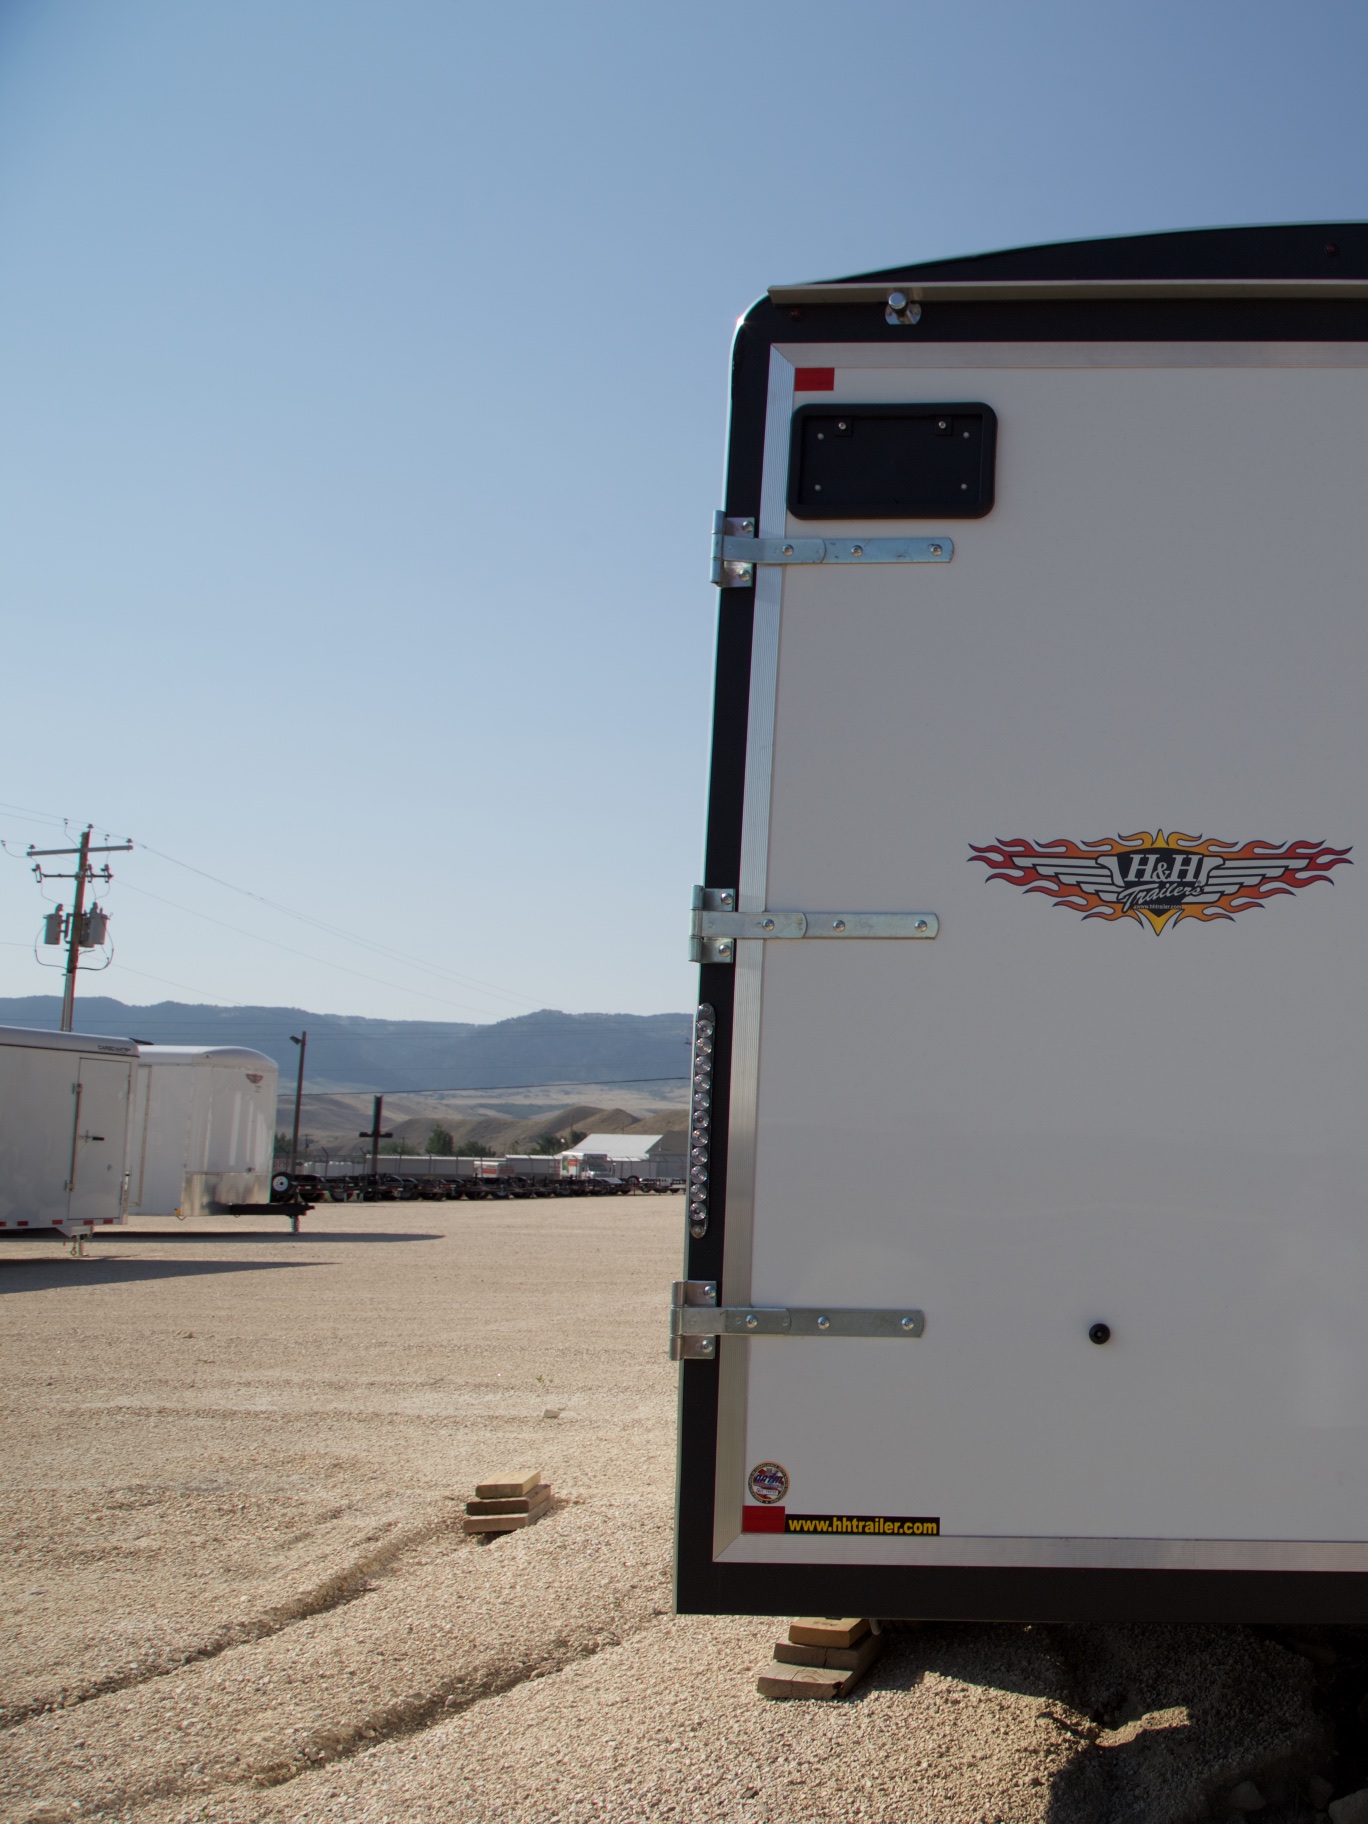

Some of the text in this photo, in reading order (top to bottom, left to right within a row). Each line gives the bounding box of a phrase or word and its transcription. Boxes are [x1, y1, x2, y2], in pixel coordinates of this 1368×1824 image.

[1124, 854, 1202, 882] H&H
[1118, 882, 1202, 912] Trailers
[788, 1516, 937, 1535] www.hhtrailer.com
